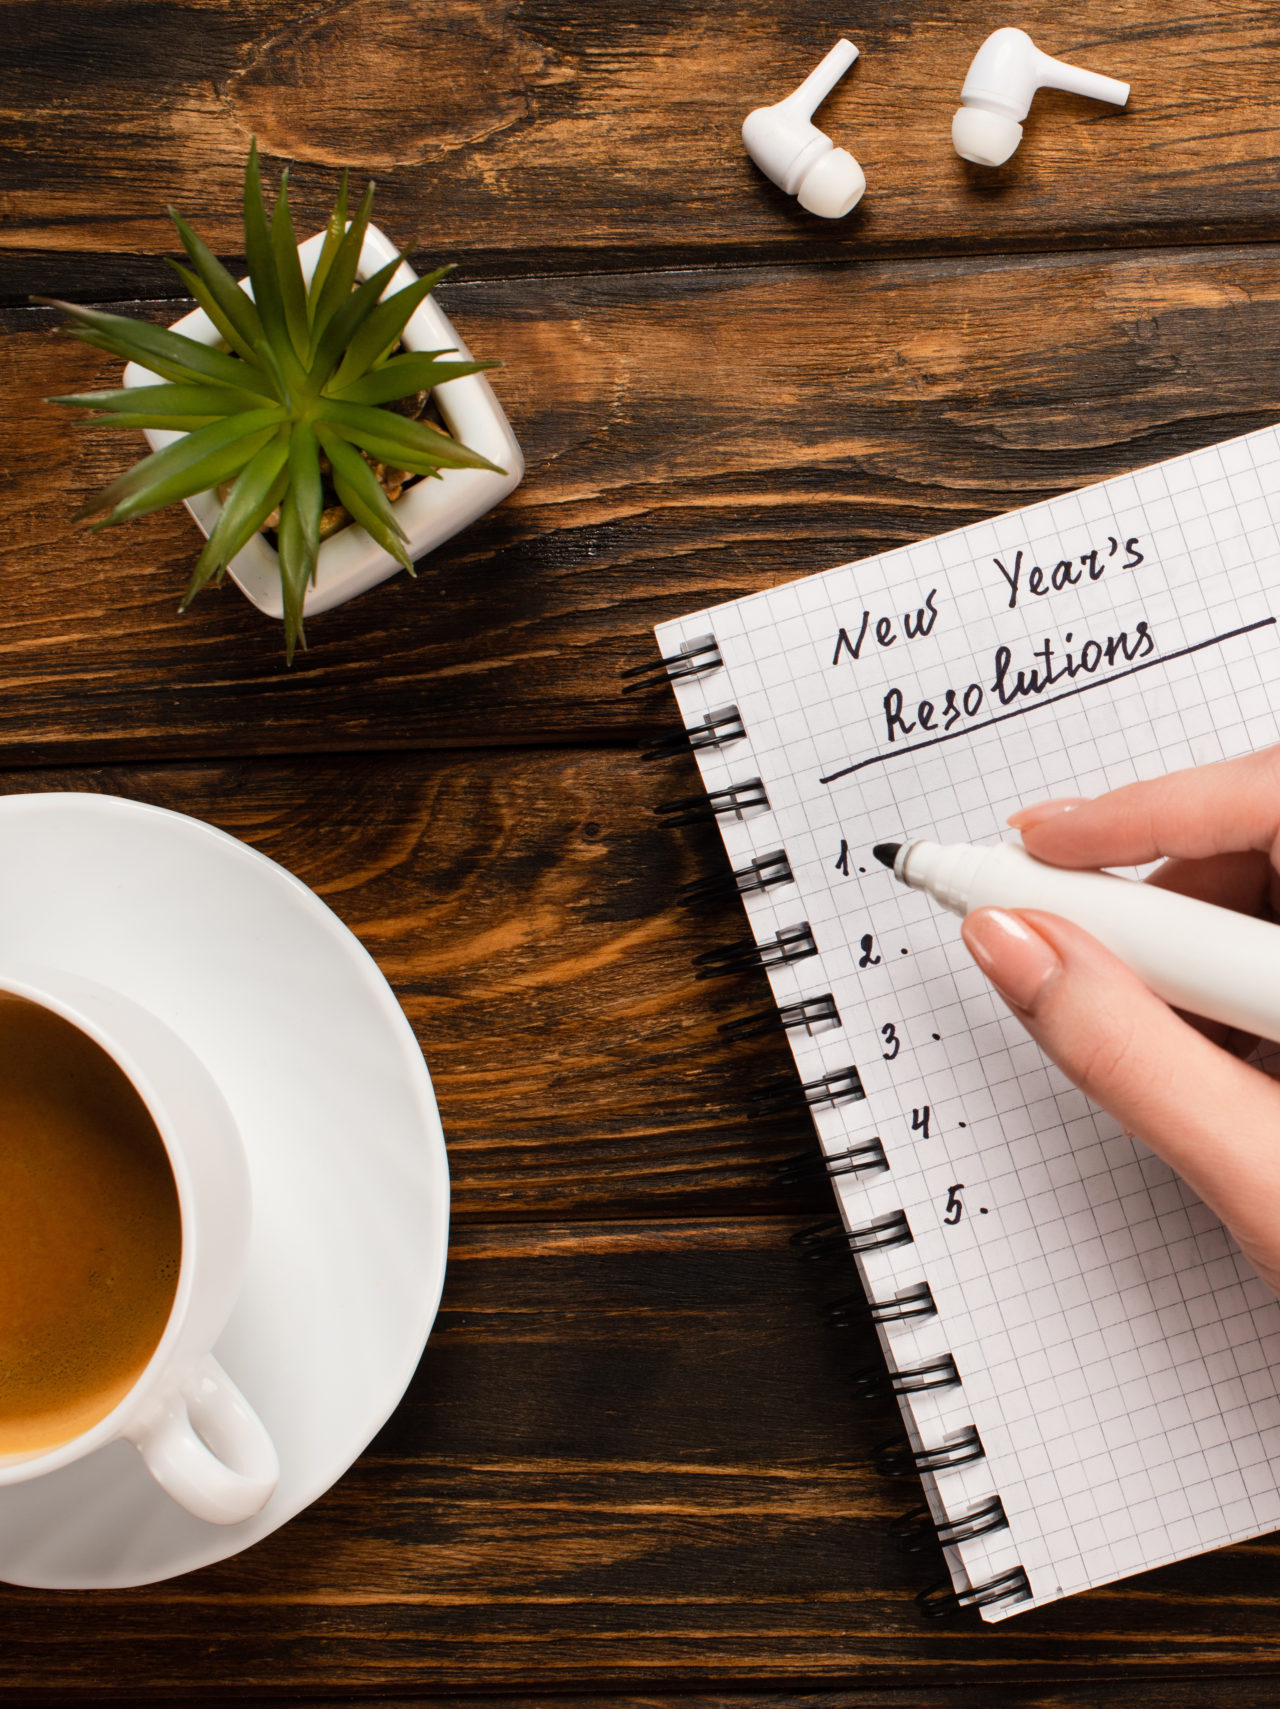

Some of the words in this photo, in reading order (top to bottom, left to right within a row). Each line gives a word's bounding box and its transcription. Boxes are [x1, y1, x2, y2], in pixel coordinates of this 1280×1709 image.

[832, 588, 938, 666] New
[993, 536, 1145, 609] Year's
[883, 621, 1154, 743] Resolutions
[834, 839, 866, 877] 1.
[858, 933, 908, 968] 2.
[881, 1022, 941, 1061] 3.
[911, 1105, 967, 1140] 4.
[943, 1183, 989, 1226] 5.
